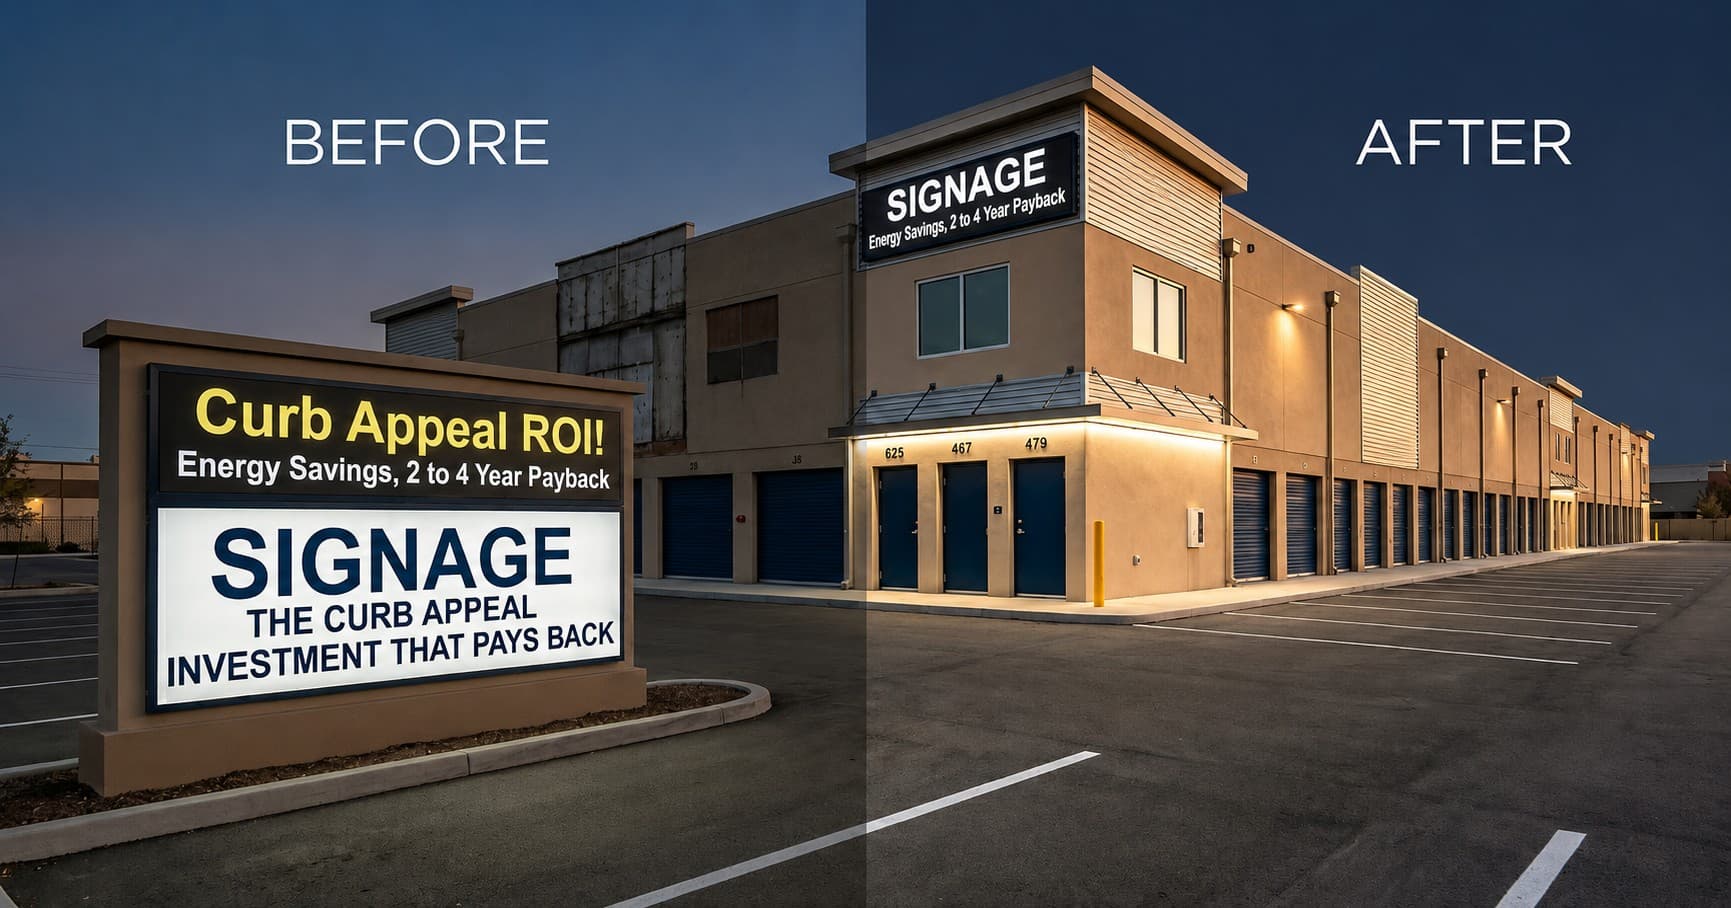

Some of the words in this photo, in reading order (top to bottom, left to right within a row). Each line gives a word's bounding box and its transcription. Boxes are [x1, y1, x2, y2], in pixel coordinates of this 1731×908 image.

[887, 148, 1046, 222] SIGNAGE
[869, 230, 902, 250] Energy
[904, 220, 948, 241] Savings,
[950, 214, 957, 229] 2
[959, 212, 971, 228] to
[973, 208, 981, 223] 4
[984, 204, 1010, 221] Year
[1013, 187, 1066, 215] Payback
[195, 387, 332, 441] Curb
[346, 400, 508, 456] Appeal
[522, 413, 605, 456] ROI!
[952, 442, 972, 454] 467
[1025, 437, 1048, 450] 479
[177, 450, 280, 486] Energy
[289, 455, 400, 488] Savings,
[406, 460, 420, 484] 2
[427, 462, 450, 485] to
[455, 462, 469, 485] 4
[475, 463, 522, 487] Year
[528, 467, 610, 491] Payback
[885, 447, 904, 459] 625
[211, 527, 572, 599] SIGNAGE
[247, 606, 313, 638] THE
[324, 601, 413, 633] CURB
[422, 594, 537, 626] APPEAL
[167, 640, 382, 687] INVESTMENT
[390, 633, 465, 663] THAT
[473, 627, 540, 657] PAYS
[547, 621, 615, 650] BACK
